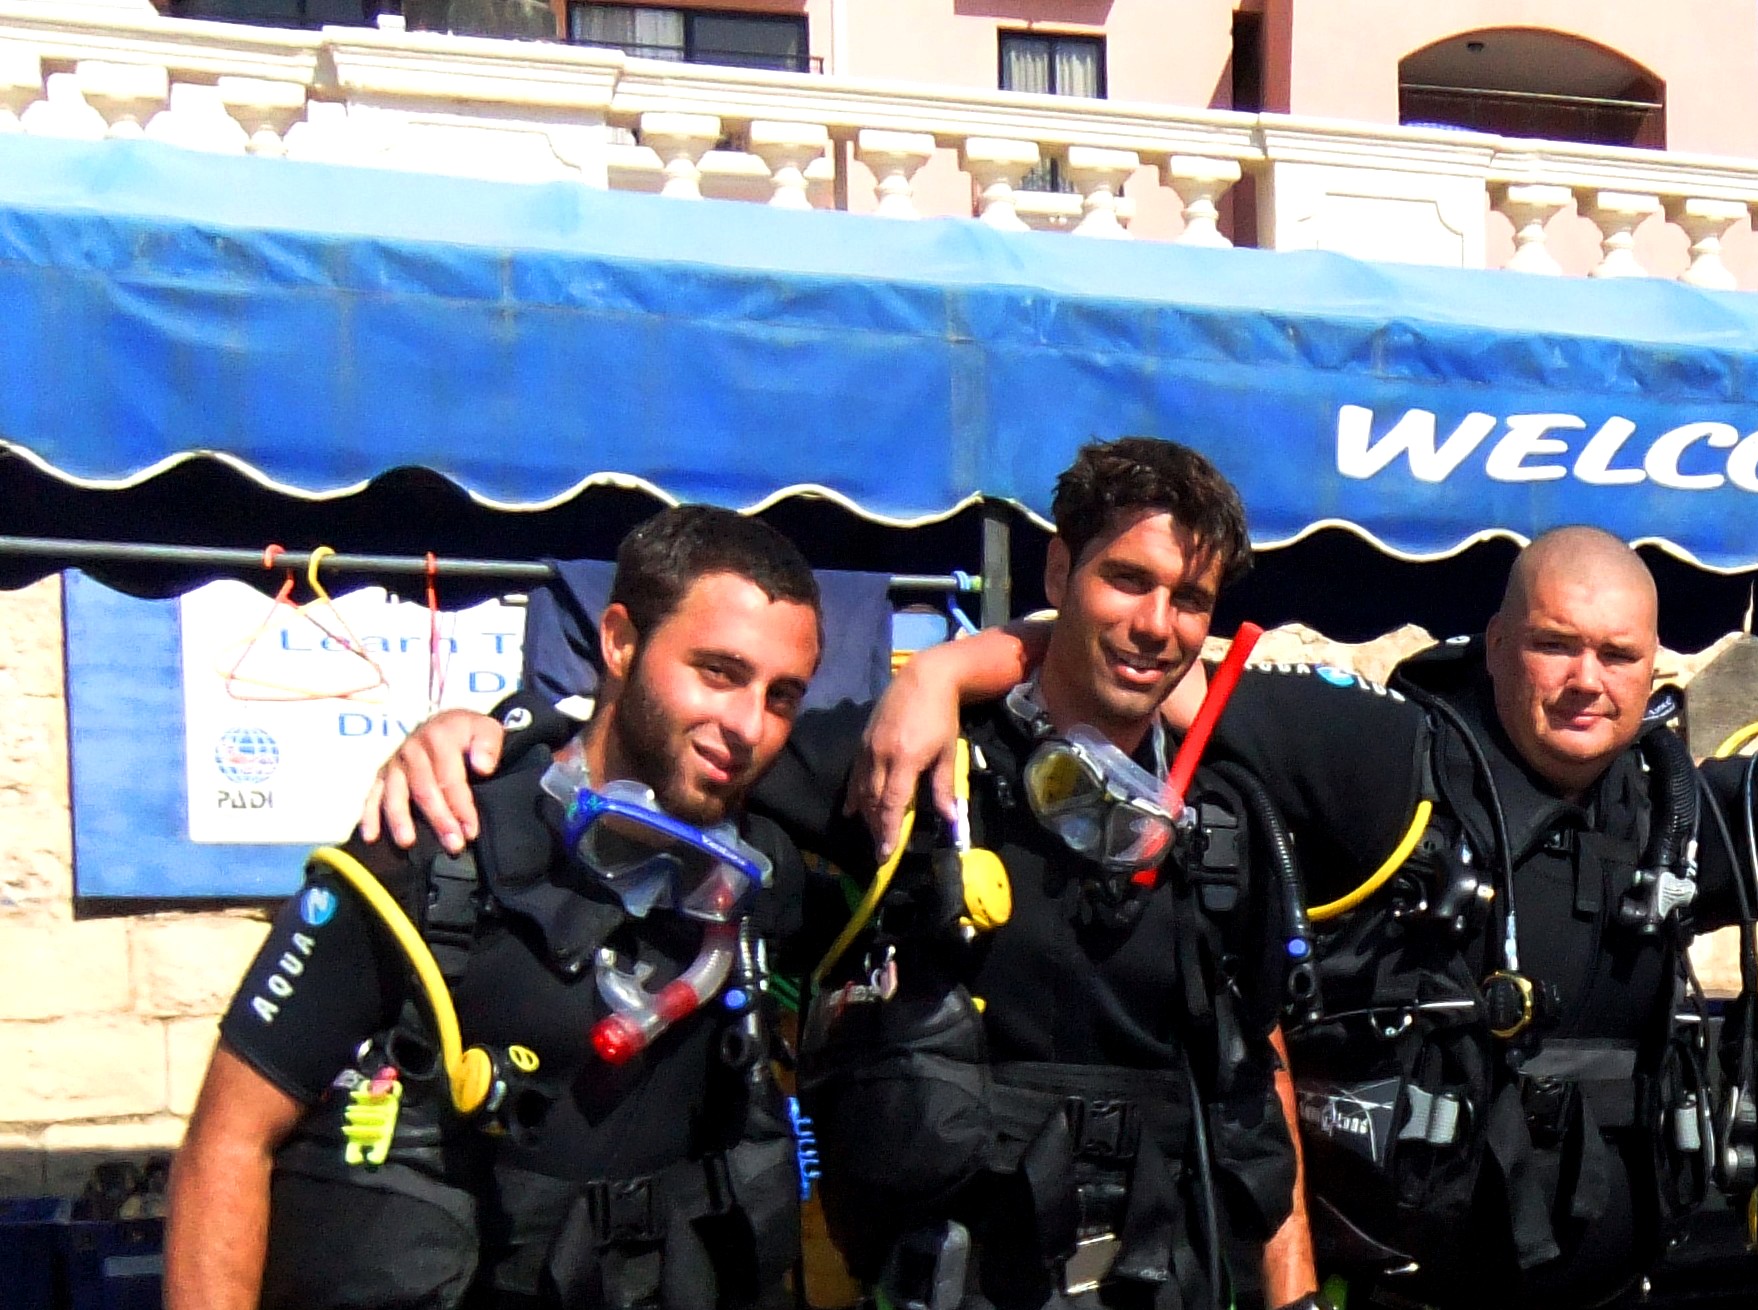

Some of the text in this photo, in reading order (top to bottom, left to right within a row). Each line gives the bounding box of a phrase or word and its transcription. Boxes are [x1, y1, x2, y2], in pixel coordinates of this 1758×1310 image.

[481, 632, 524, 654] T
[217, 790, 273, 809] PADI
[252, 932, 316, 1024] AQUA
